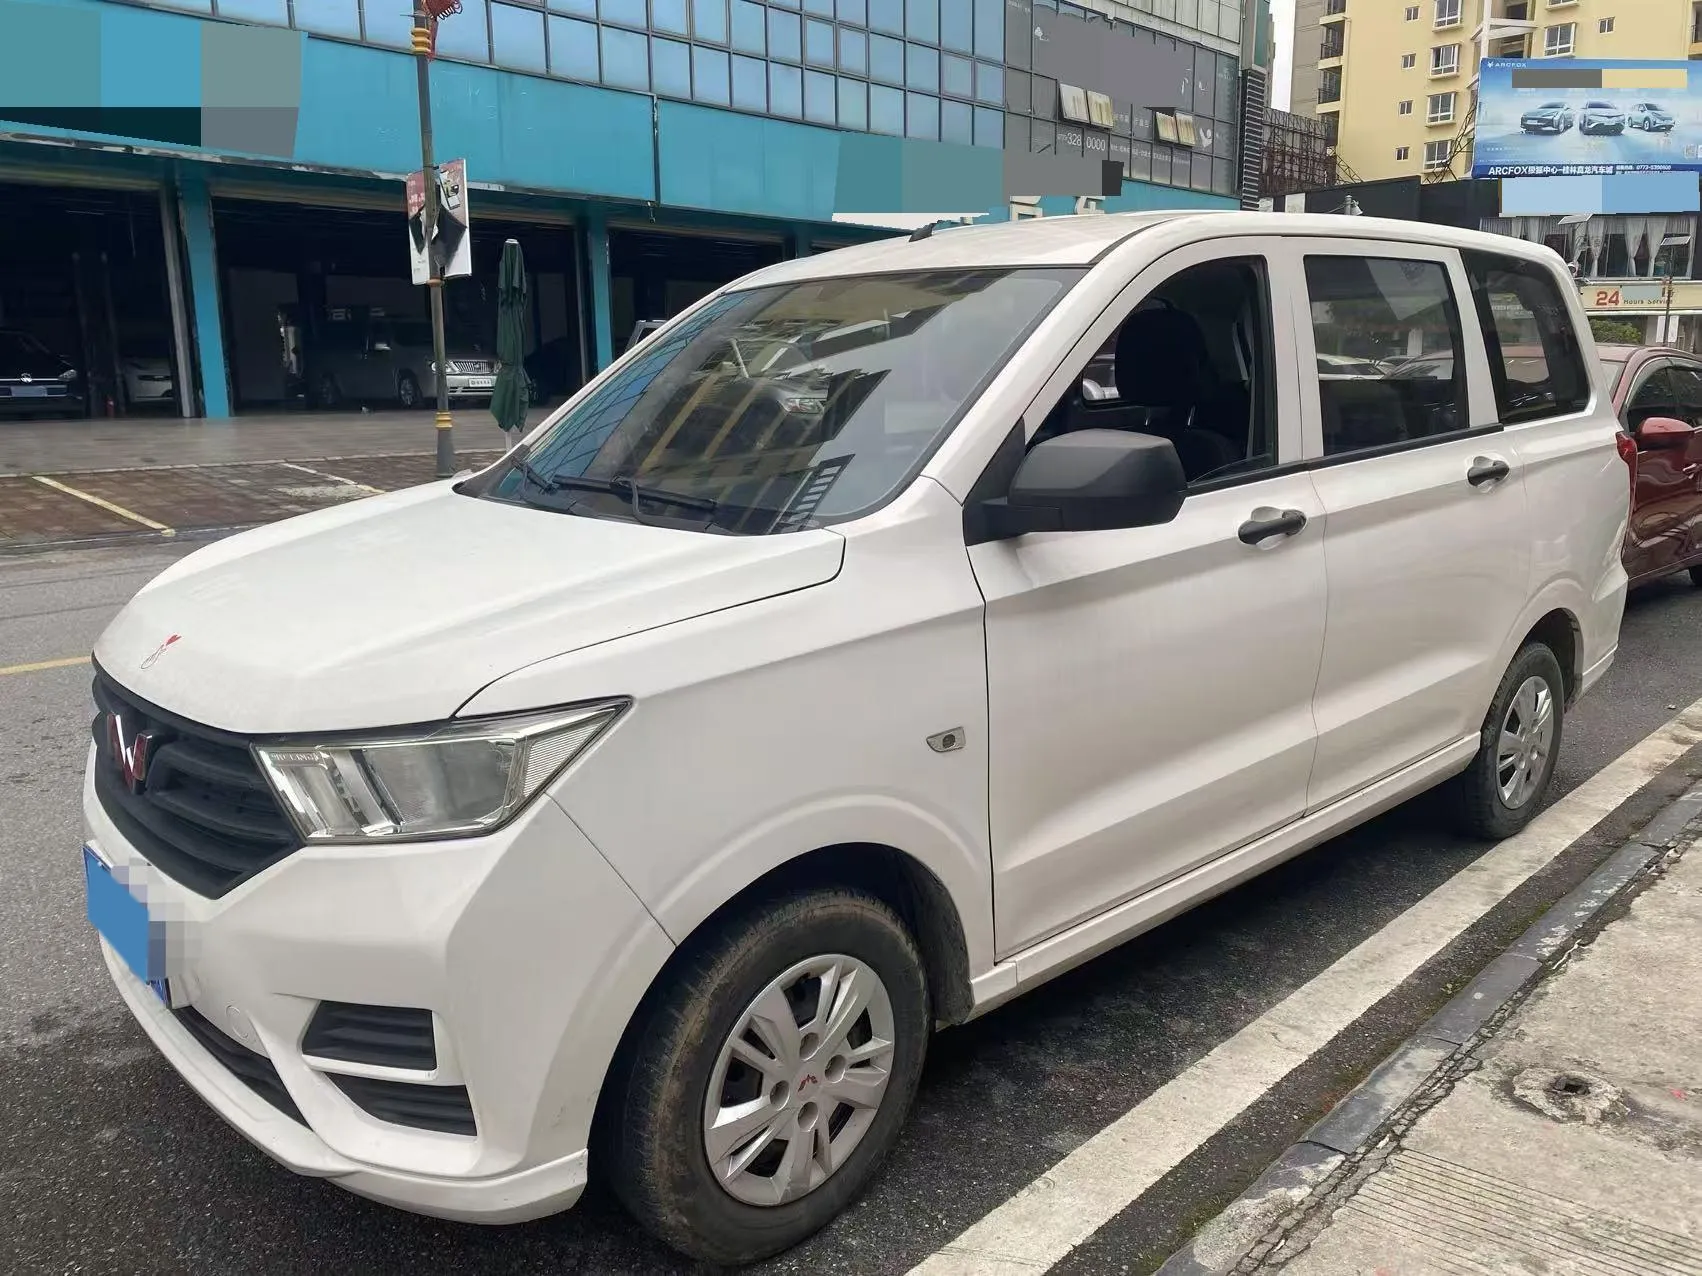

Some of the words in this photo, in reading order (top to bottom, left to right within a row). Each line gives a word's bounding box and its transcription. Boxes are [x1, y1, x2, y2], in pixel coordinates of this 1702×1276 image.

[1067, 132, 1082, 147] 328
[1086, 136, 1106, 151] 0000
[1595, 290, 1620, 306] 24
